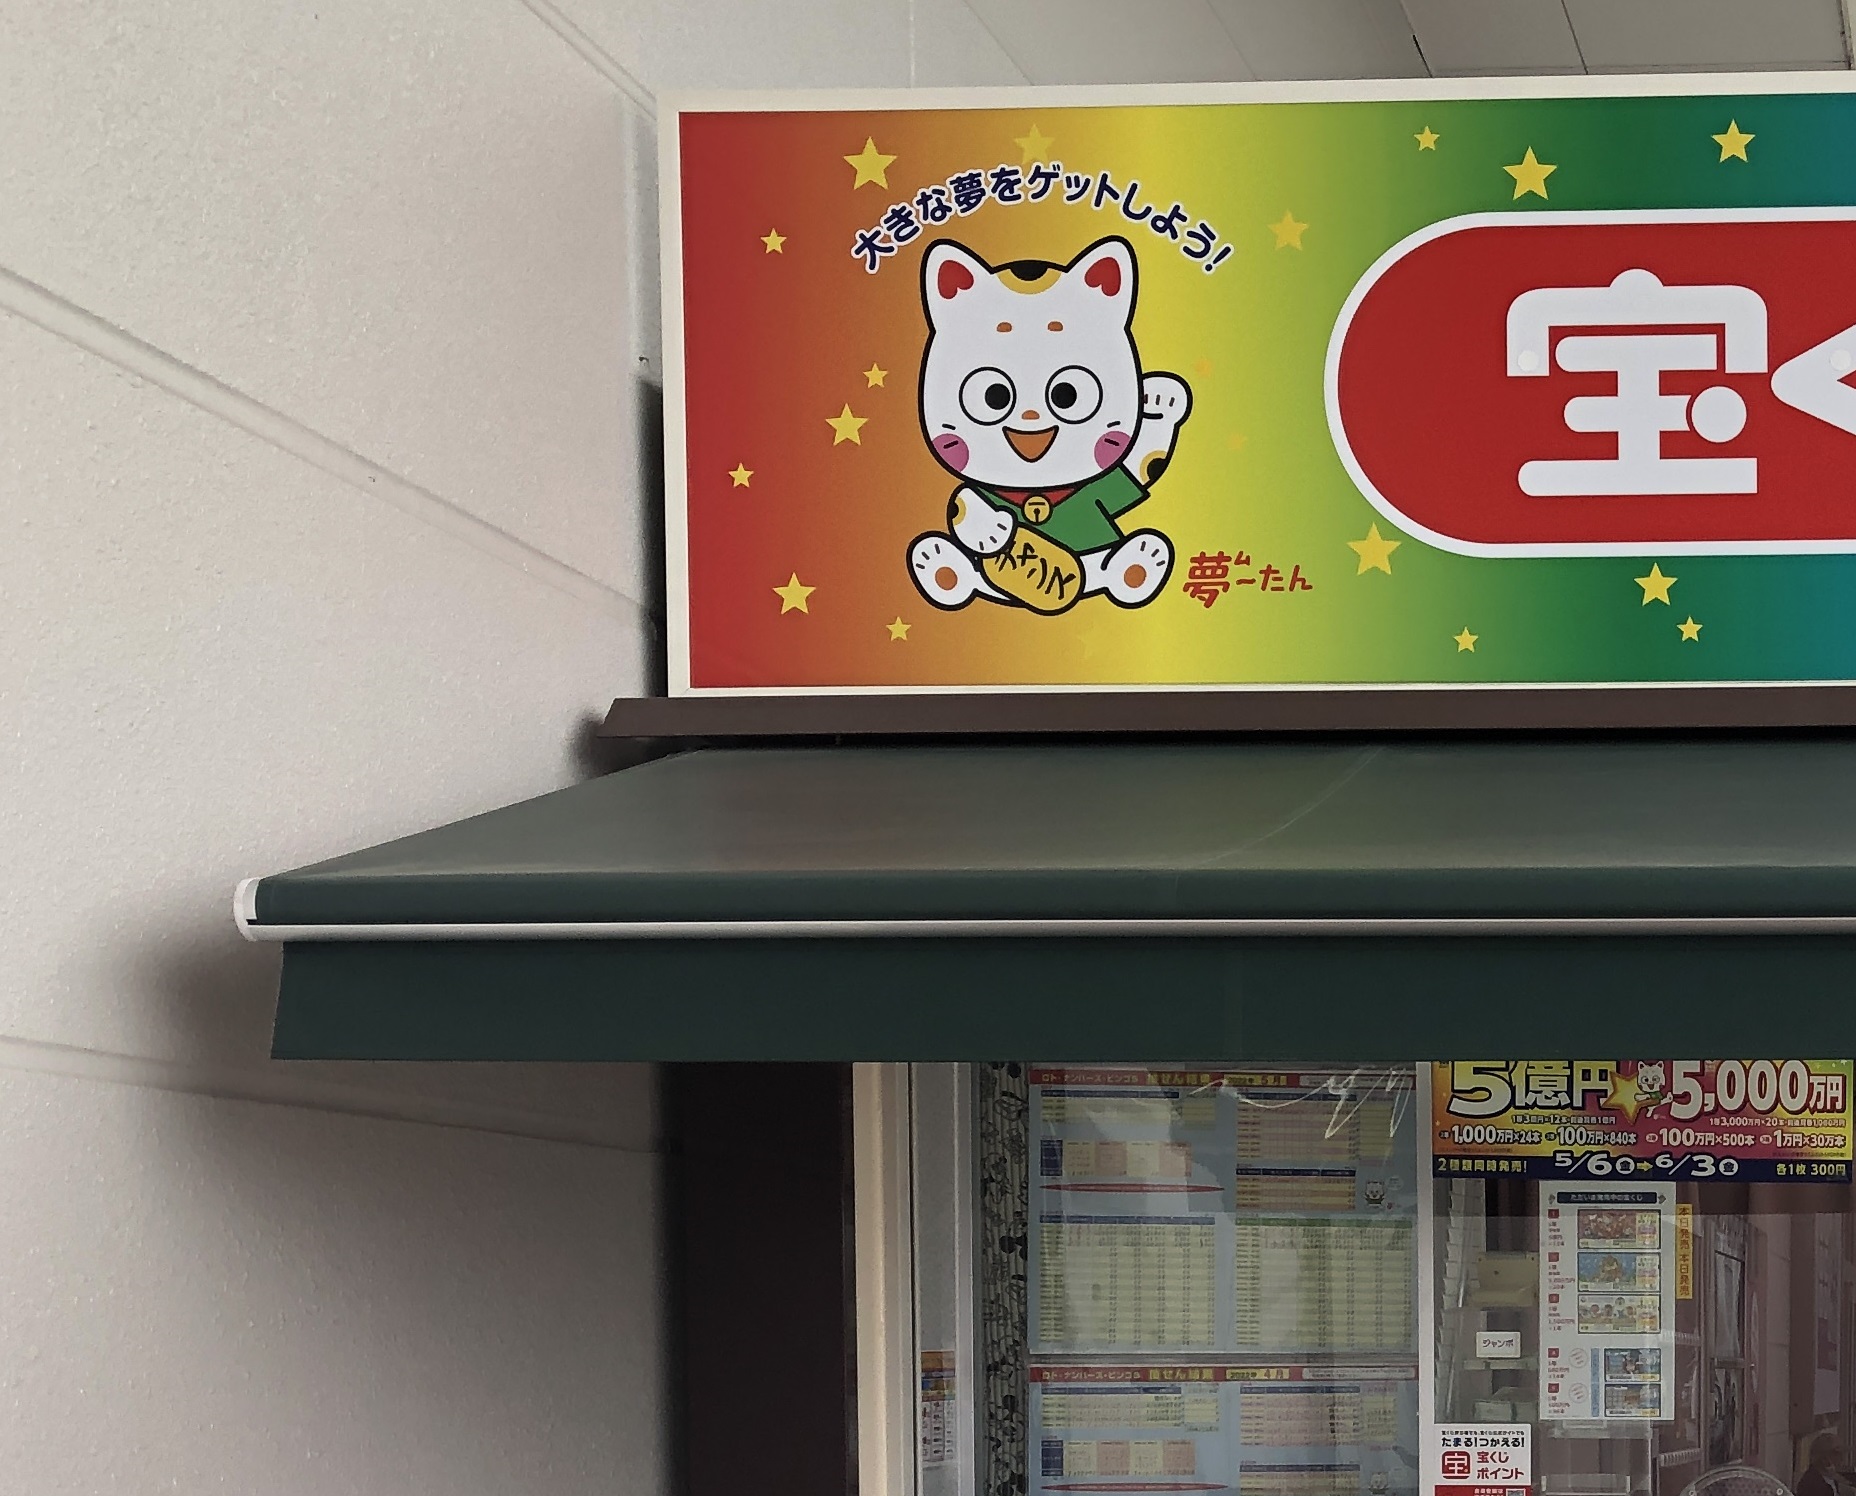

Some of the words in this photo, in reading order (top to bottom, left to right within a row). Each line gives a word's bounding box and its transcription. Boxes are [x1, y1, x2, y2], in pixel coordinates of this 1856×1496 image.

[853, 163, 1236, 274] 大きな夢をゲットしよう!
[1449, 1061, 1616, 1116] 5億円
[1670, 1060, 1843, 1119] 5,000万円
[1811, 1164, 1846, 1176] 300円
[1678, 1206, 1689, 1250] 本日発売
[1678, 1253, 1689, 1296] 本日発売
[1482, 1338, 1514, 1348] ジャンボ
[1476, 1451, 1509, 1464] 宝くじ
[1476, 1467, 1524, 1480] ポイント
